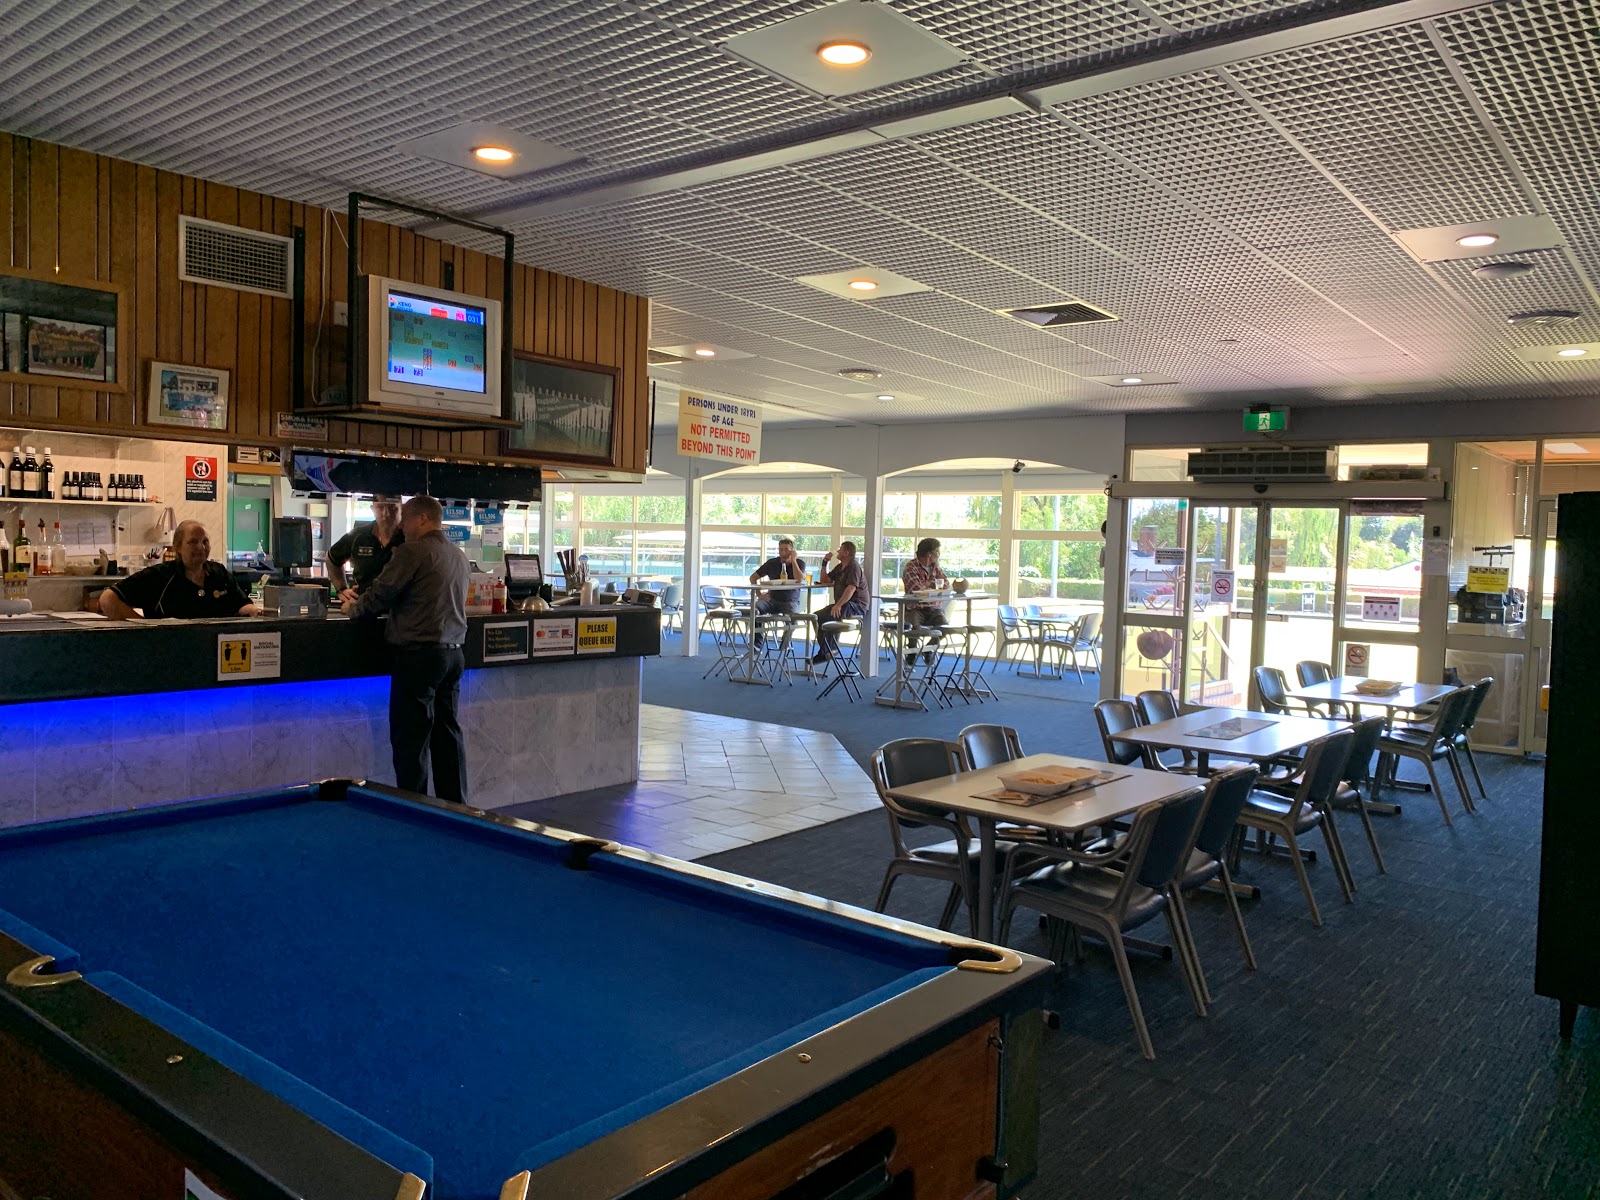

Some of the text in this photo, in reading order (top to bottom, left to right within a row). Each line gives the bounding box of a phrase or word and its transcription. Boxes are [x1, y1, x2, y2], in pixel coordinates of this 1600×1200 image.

[688, 397, 756, 418] PERSONS UNDER 18YRS
[712, 415, 734, 426] OF AGE
[690, 423, 750, 444] NOT PERMITTED
[681, 439, 756, 461] BEYOND THIS POINT
[587, 624, 608, 633] PLEASE
[579, 636, 599, 646] QUEUE
[600, 636, 615, 645] HERE
